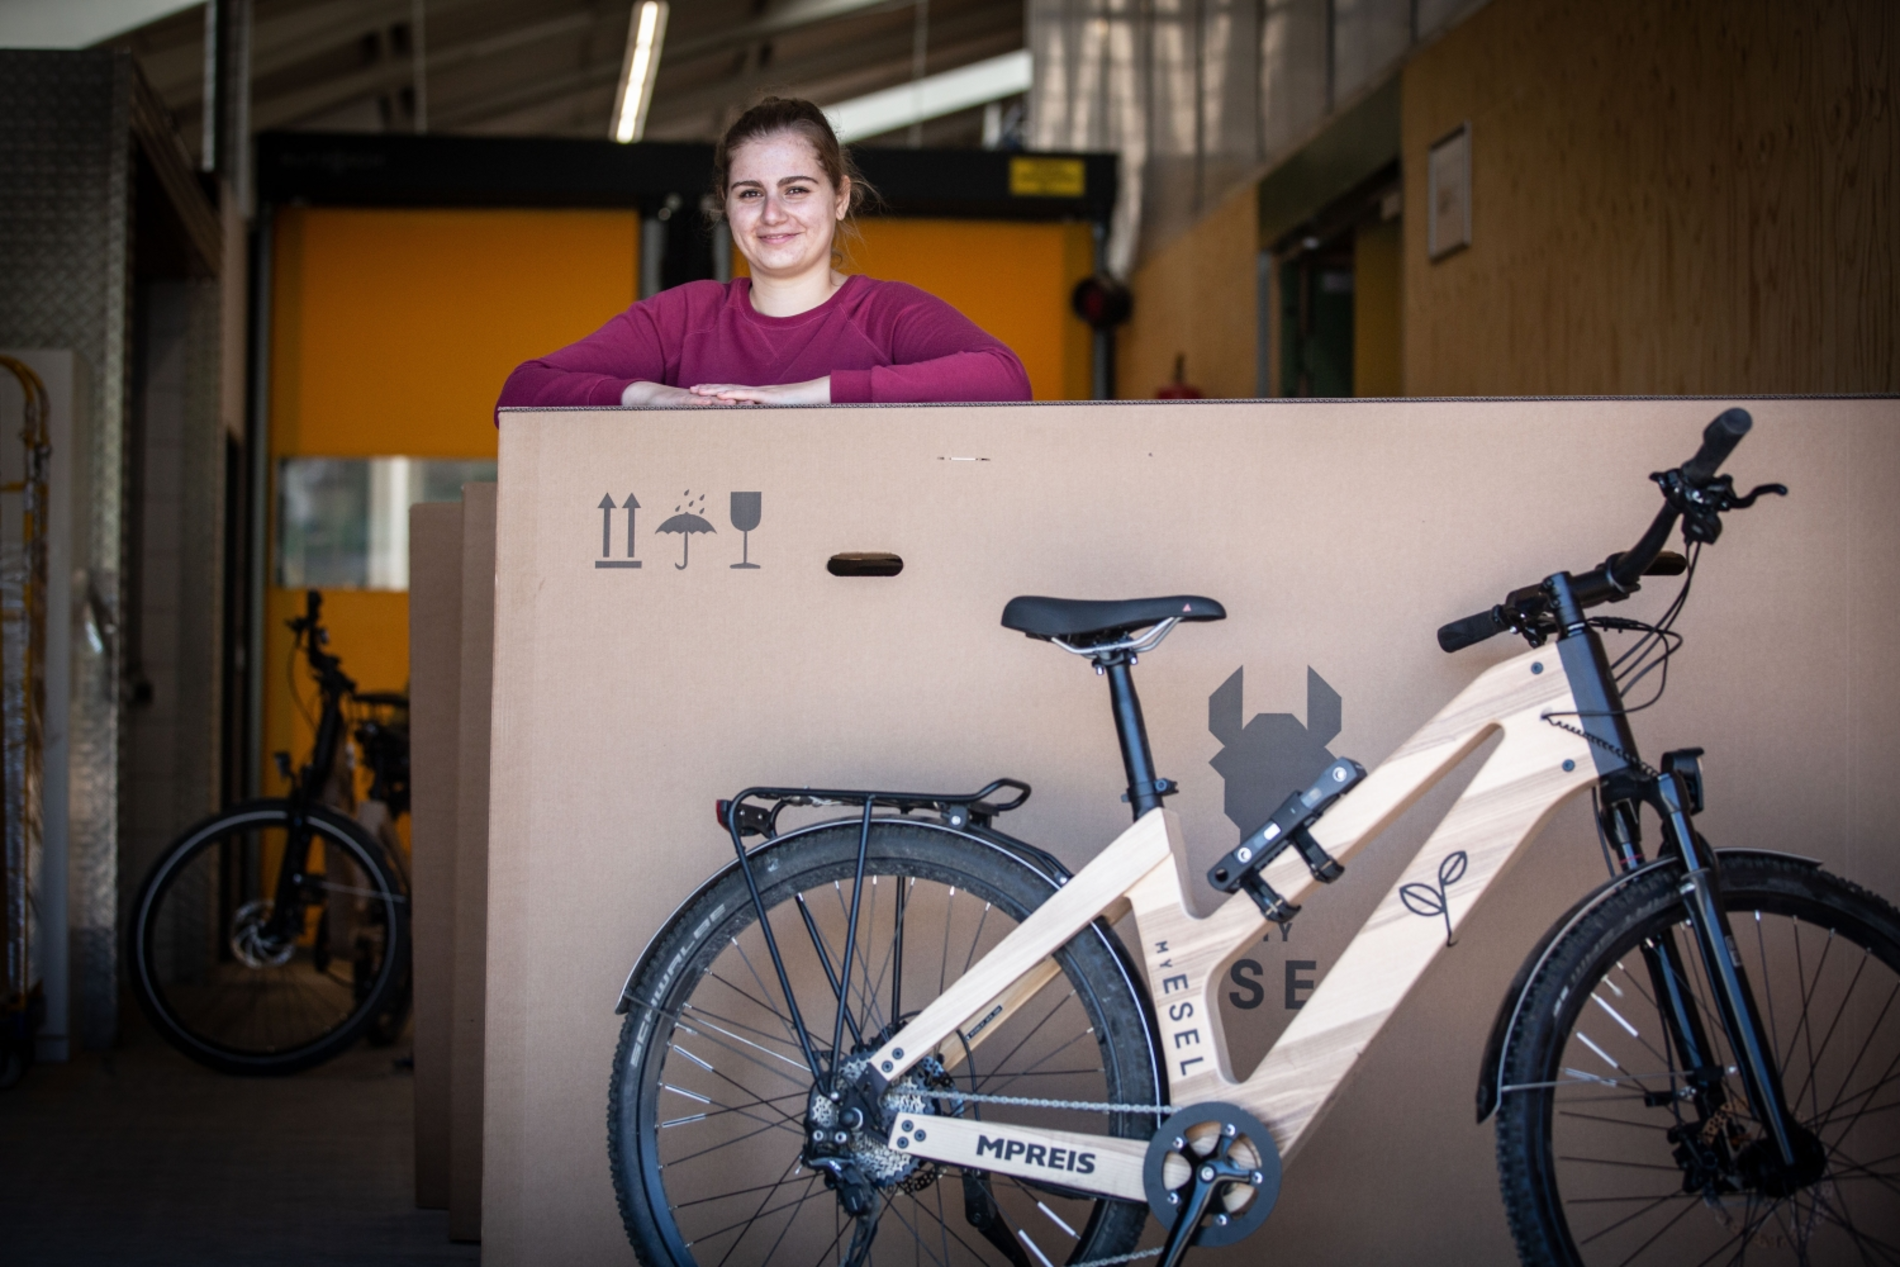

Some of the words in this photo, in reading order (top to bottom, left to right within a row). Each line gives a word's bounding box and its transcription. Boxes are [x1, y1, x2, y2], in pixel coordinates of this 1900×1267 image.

[1263, 922, 1293, 942] Y
[1229, 959, 1317, 1010] SE
[976, 1134, 1096, 1174] MPREIS
